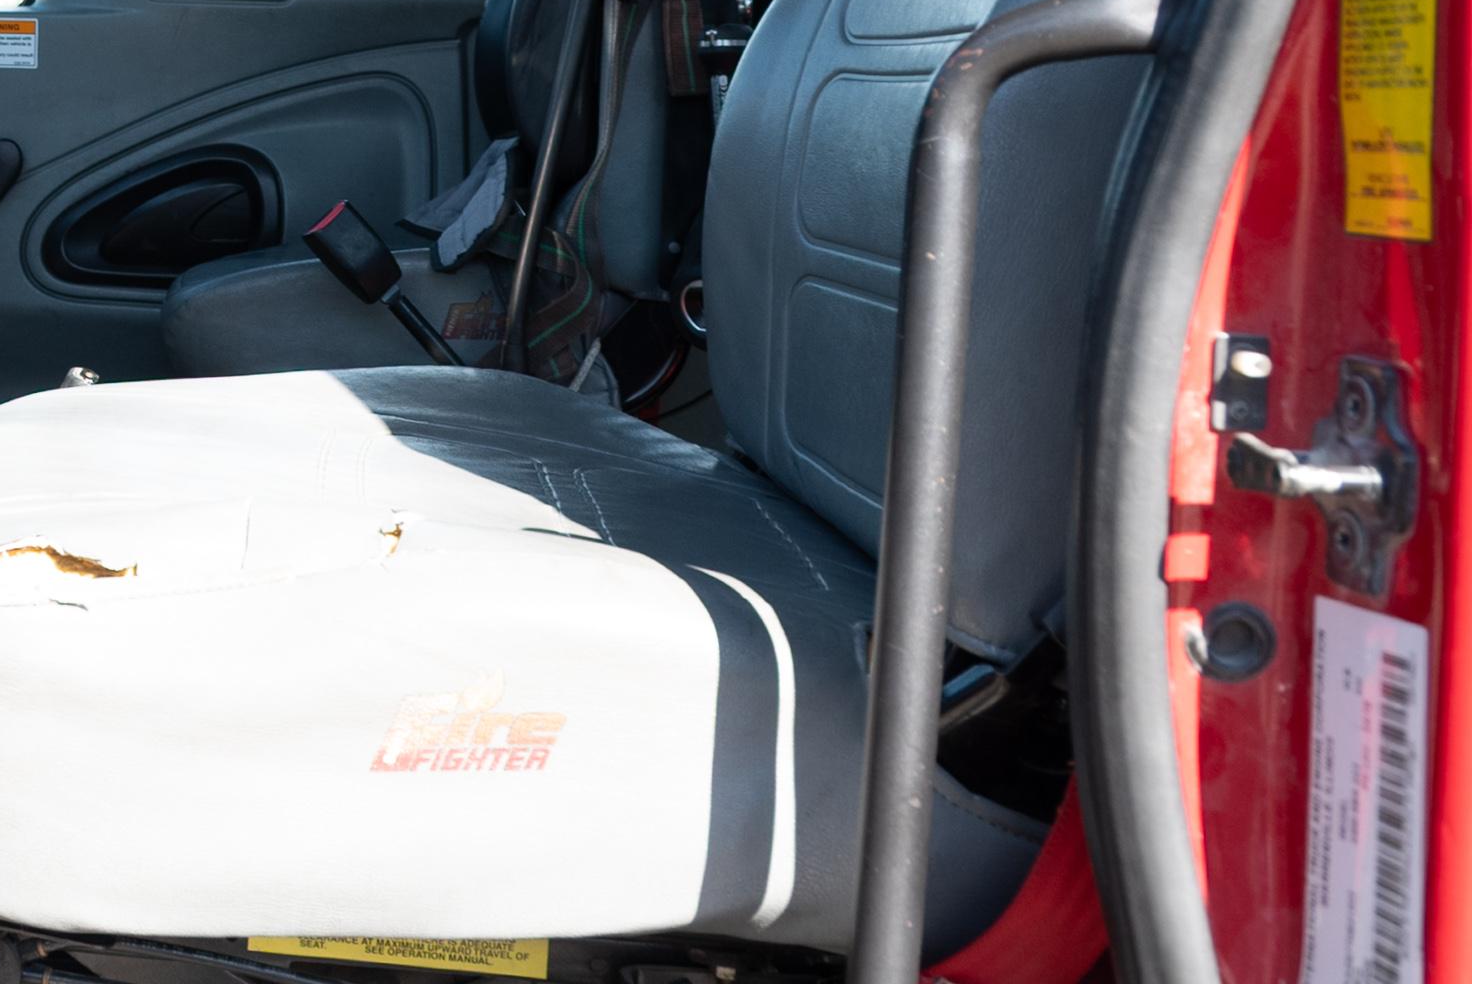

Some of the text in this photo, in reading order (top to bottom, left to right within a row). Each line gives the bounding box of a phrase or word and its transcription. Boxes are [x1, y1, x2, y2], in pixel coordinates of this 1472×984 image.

[408, 746, 551, 772] FIGHTER
[361, 937, 373, 946] AT
[376, 938, 425, 951] MAXIMUM
[428, 944, 472, 956] UPWARD
[474, 947, 512, 960] TRAVEL
[515, 952, 530, 961] OF
[364, 945, 385, 955] SEE
[387, 946, 446, 961] OPERATION
